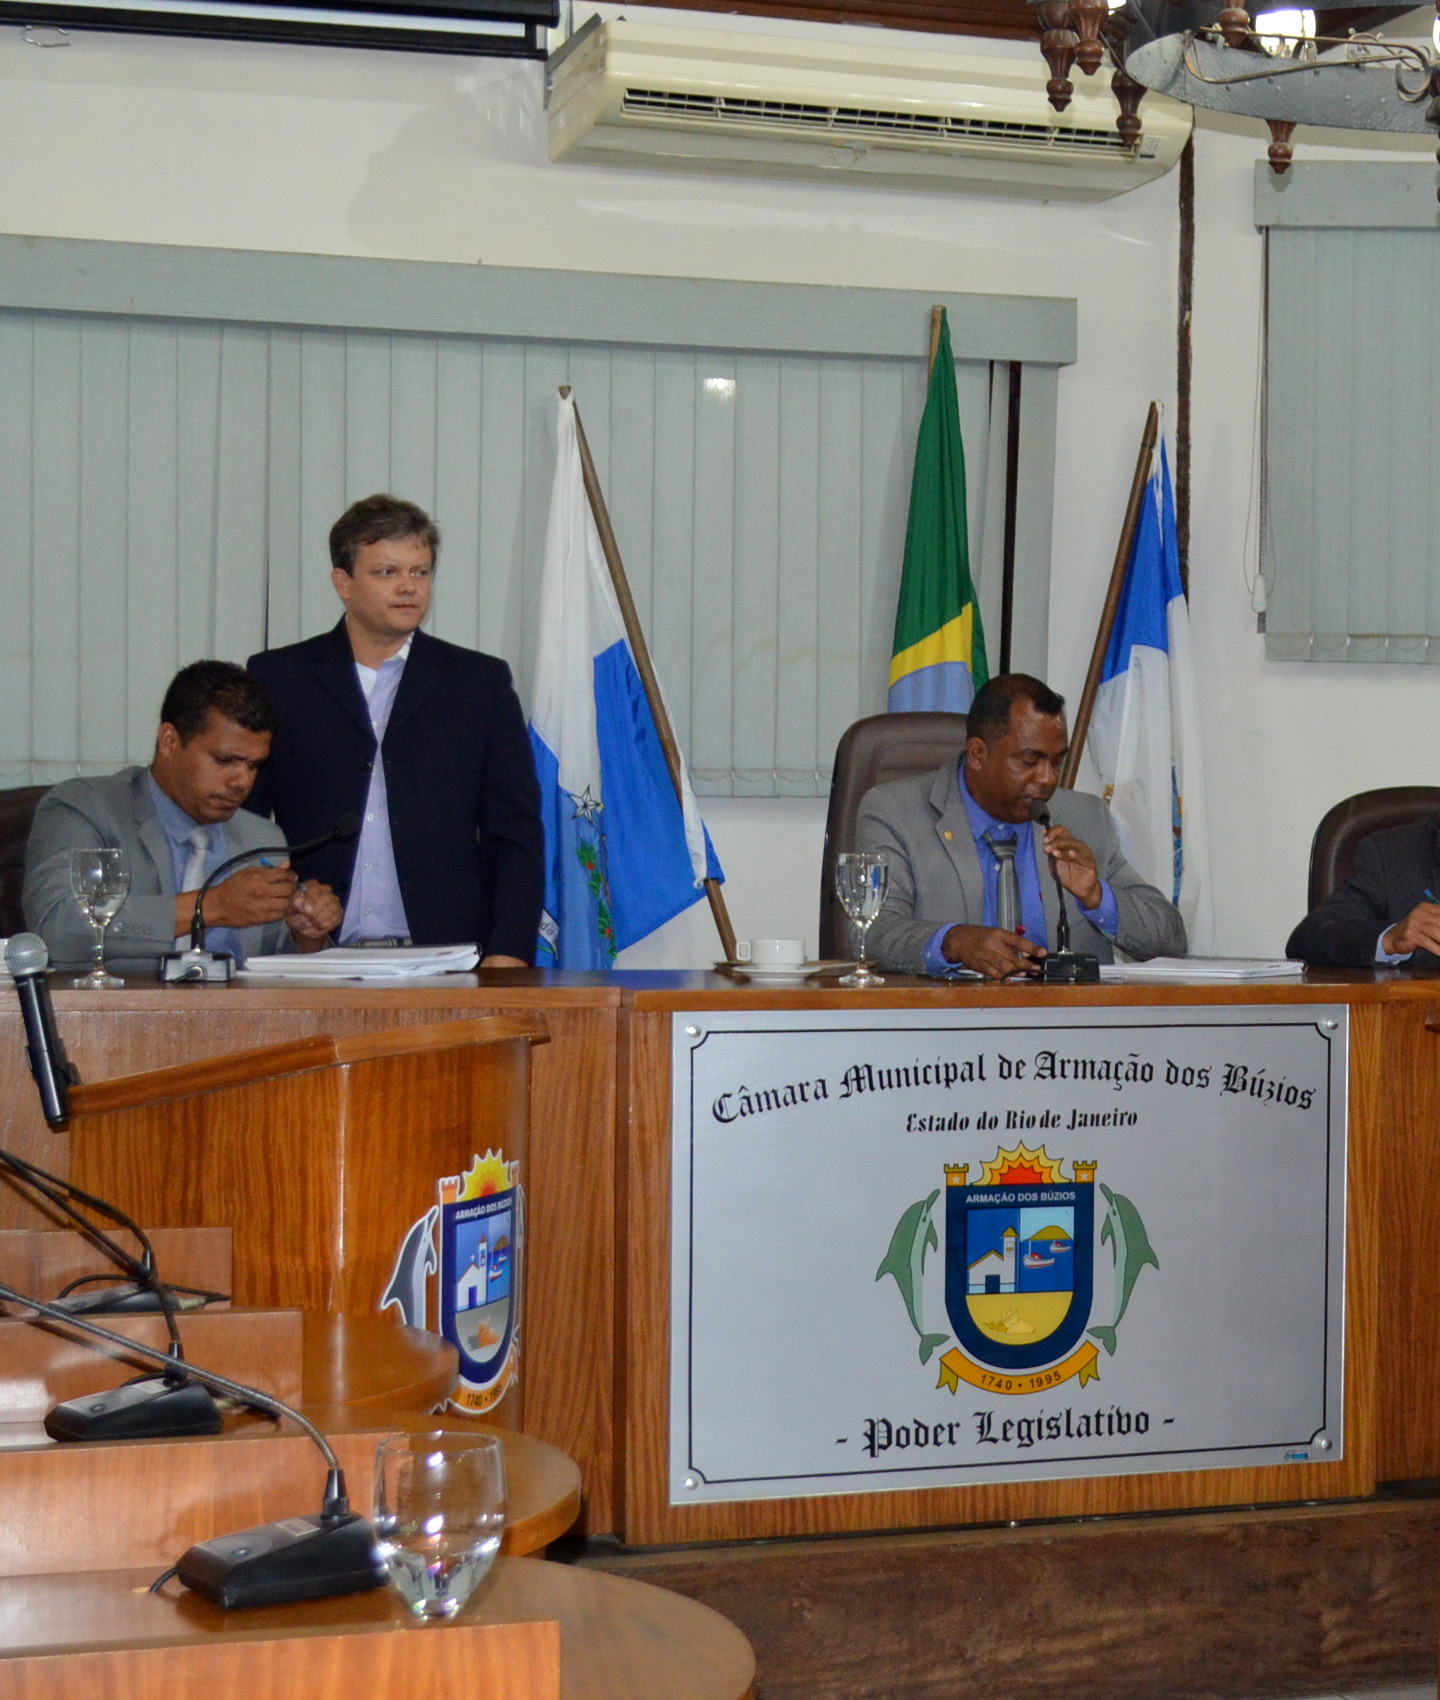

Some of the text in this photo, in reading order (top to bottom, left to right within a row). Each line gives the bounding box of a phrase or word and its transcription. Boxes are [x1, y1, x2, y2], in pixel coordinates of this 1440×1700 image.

[712, 1050, 1317, 1124] Câmara Municipal de Armação dos Búzios
[906, 1107, 1138, 1132] Estado do Rio de Janeiro
[486, 1202, 498, 1213] DOS
[966, 1190, 1076, 1204] ARMAÇÃO DOS BÚZIOS
[981, 1370, 1061, 1391] 1740 1995
[466, 1393, 483, 1407] 1740
[861, 1417, 961, 1458] Poder
[972, 1405, 1149, 1448] Legislativo
